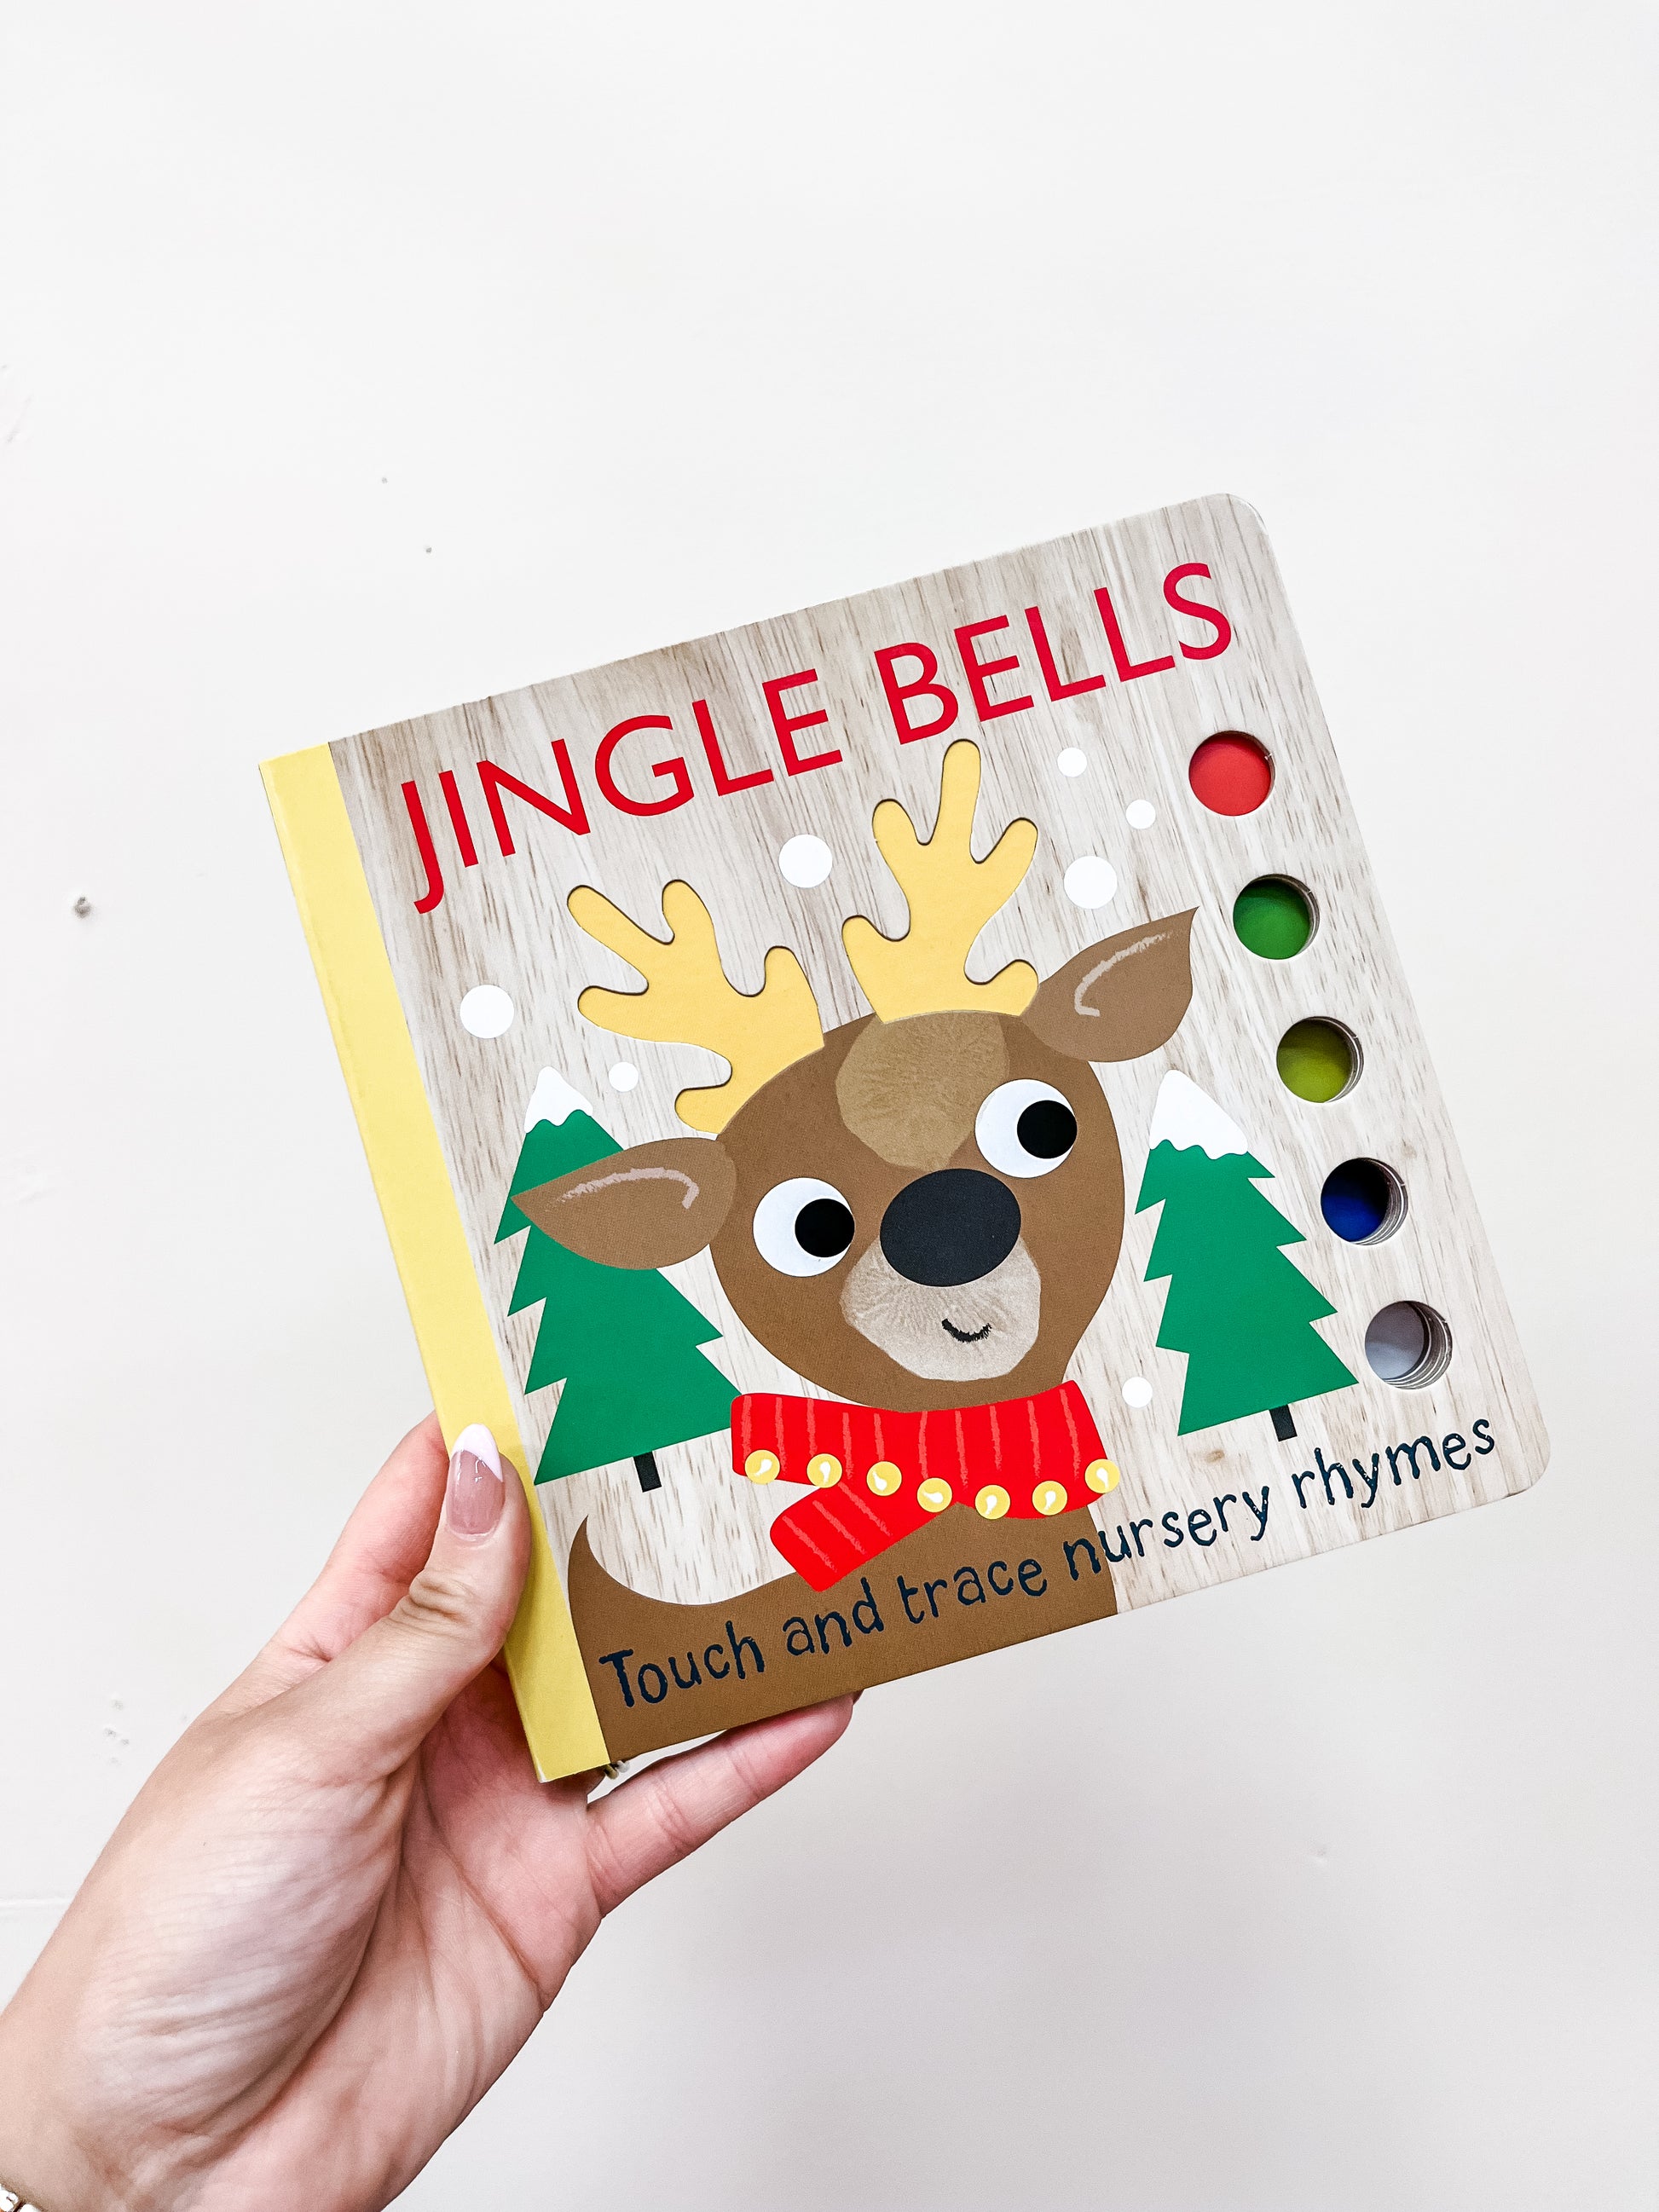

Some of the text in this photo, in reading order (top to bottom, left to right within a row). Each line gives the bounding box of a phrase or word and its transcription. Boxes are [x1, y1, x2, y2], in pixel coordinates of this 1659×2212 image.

[401, 562, 1232, 915] JINGLE BELLS
[598, 1418, 1495, 1708] Touch and trace nursery rhymes
